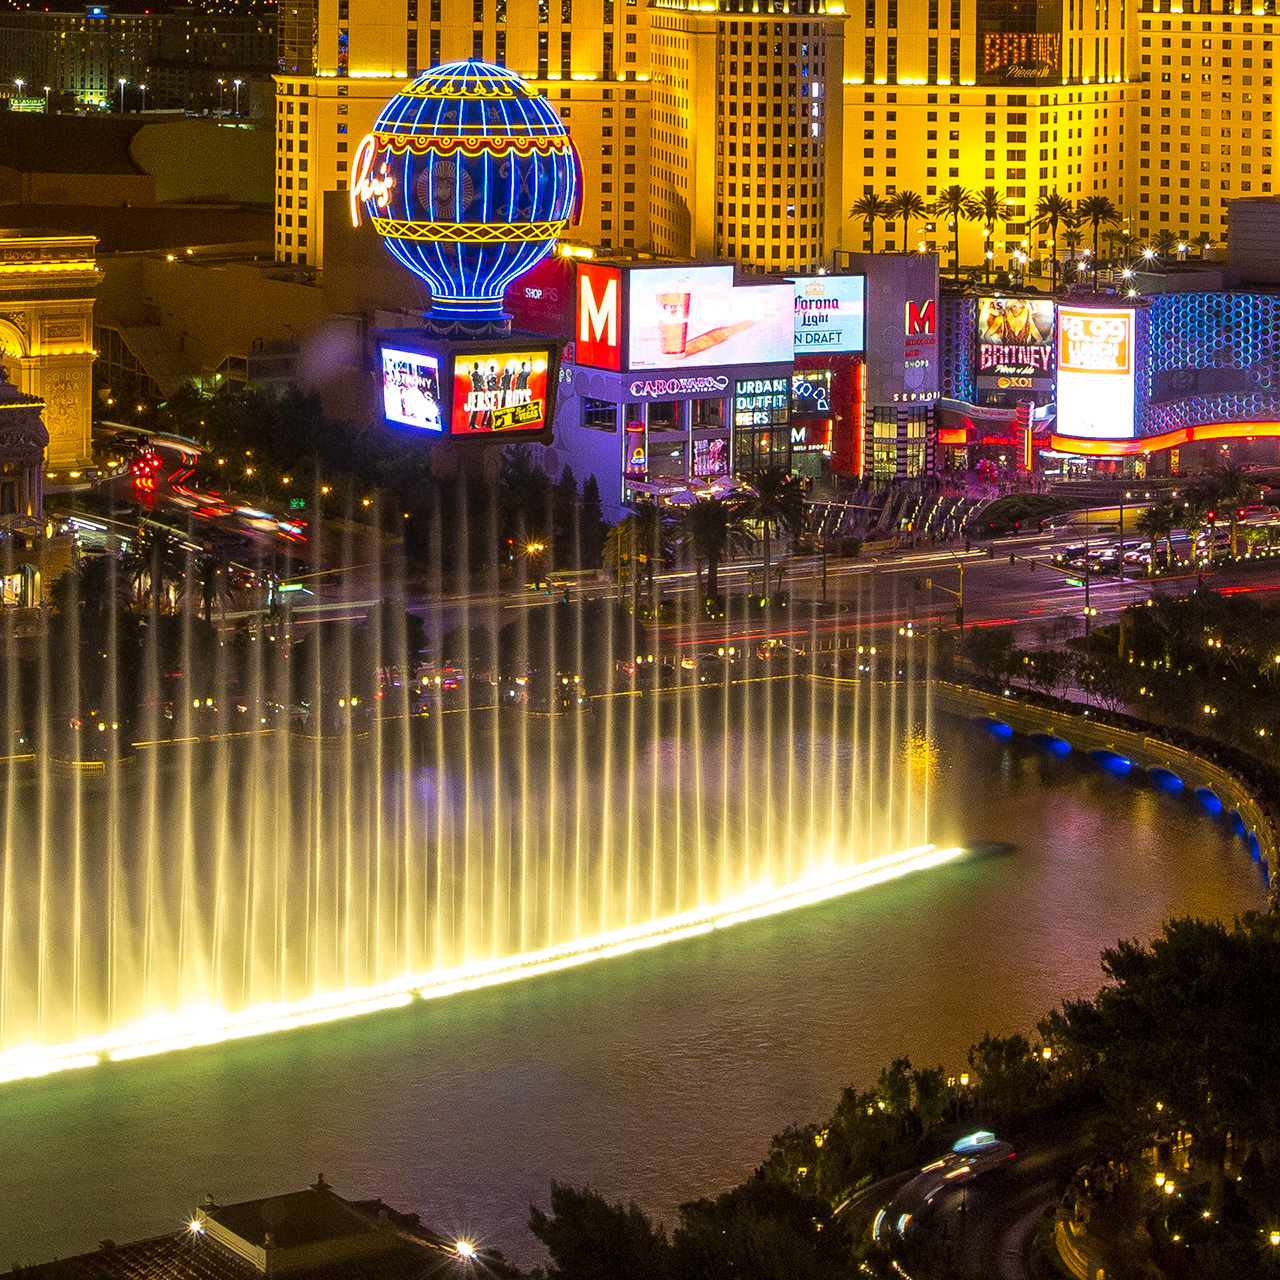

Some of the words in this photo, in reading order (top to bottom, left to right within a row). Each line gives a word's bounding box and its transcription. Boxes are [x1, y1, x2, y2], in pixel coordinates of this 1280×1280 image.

[983, 32, 1060, 74] BRITNEY
[350, 133, 394, 228] Paris
[580, 275, 617, 347] M
[801, 312, 829, 327] Light
[904, 300, 935, 336] M
[805, 332, 843, 344] DRAFT
[1061, 317, 1127, 344] $8.99
[904, 359, 930, 369] SHOPS
[980, 344, 1052, 372] BRITNEY
[629, 378, 680, 397] CABO
[736, 379, 784, 395] URBAN
[1009, 378, 1033, 388] KOI
[463, 390, 503, 412] JERSEY
[505, 388, 532, 408] BOYS
[736, 394, 786, 410] OUTFIT
[893, 390, 940, 402] SEPHOR
